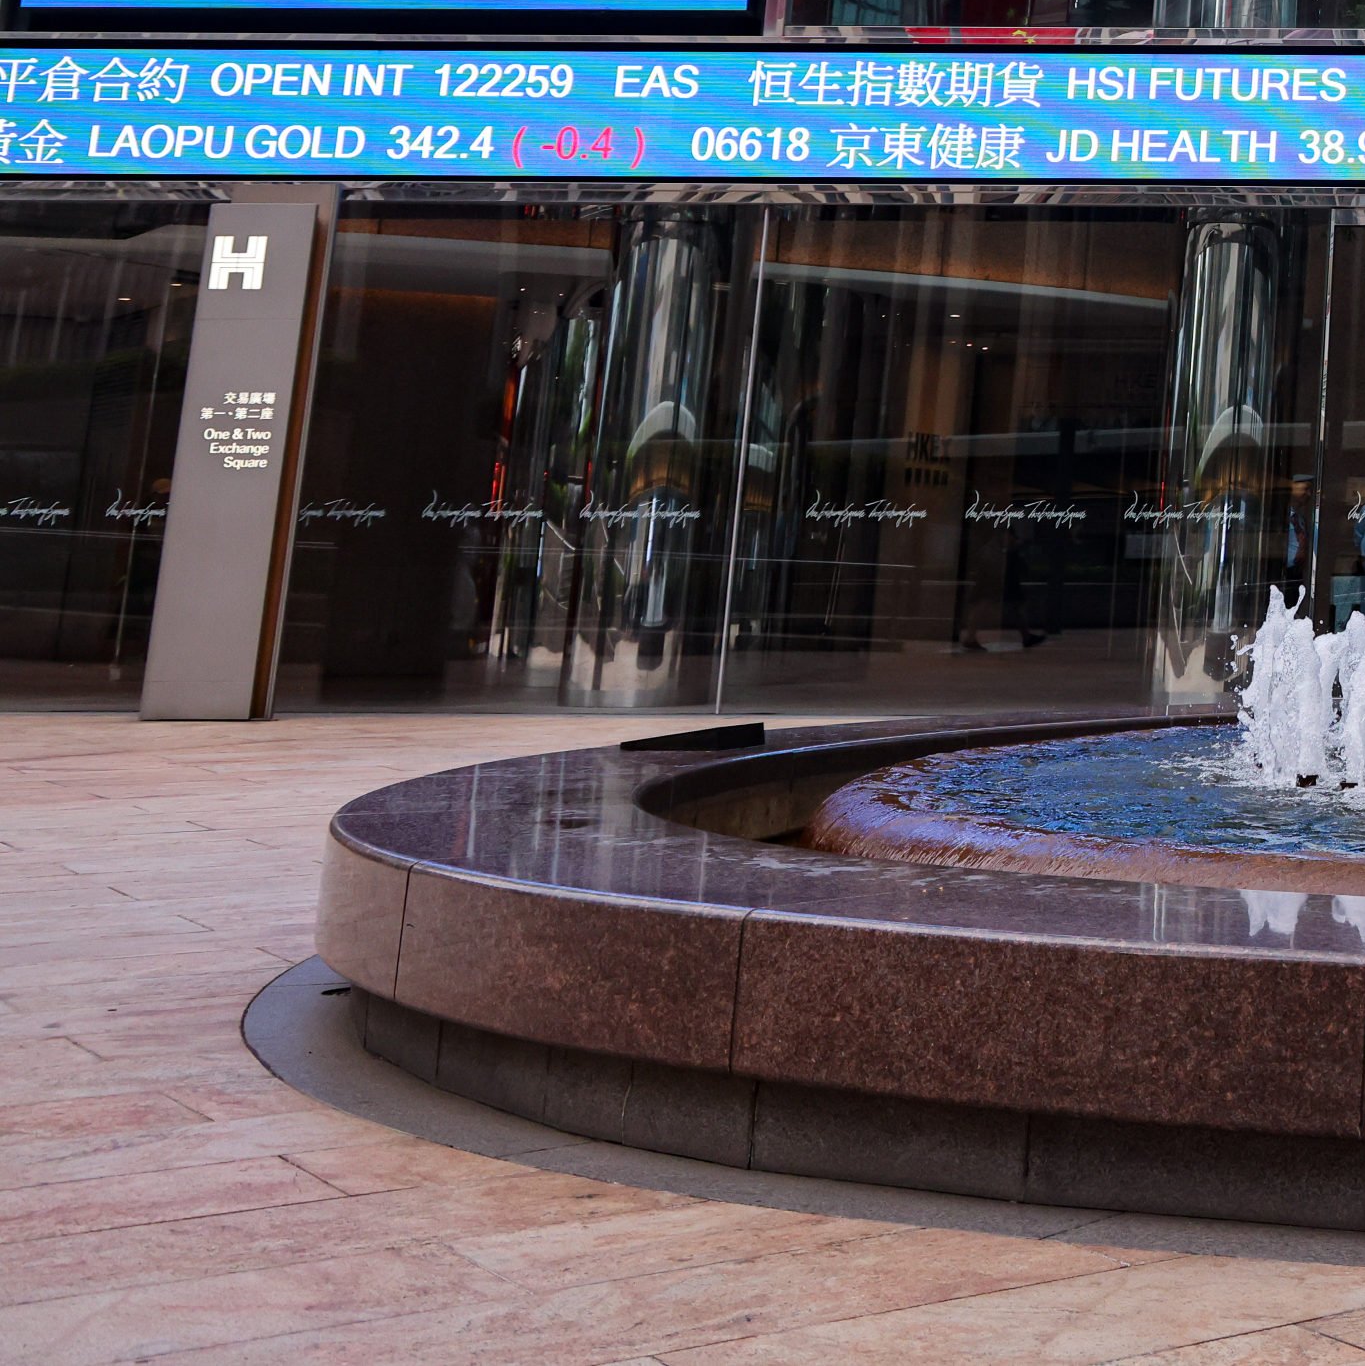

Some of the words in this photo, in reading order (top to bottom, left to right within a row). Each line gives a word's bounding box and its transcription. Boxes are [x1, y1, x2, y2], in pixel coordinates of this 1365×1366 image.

[211, 63, 331, 96] OPEN
[344, 65, 413, 95] INT
[436, 64, 573, 97] 122259
[615, 65, 698, 98] EAS
[749, 61, 1043, 107] 恒生指數期貨
[1068, 67, 1135, 100] HSI
[1150, 68, 1346, 101] FUTURES
[89, 125, 233, 158] LAOPU
[246, 125, 365, 158] GOLD
[387, 126, 493, 158] 342.4
[692, 127, 809, 161] 06618
[827, 124, 1025, 169] 京東健康
[1047, 130, 1098, 162] JD
[1111, 130, 1276, 162] HEALTH
[204, 428, 230, 439] One
[232, 428, 243, 439] &
[246, 429, 271, 439] Two
[210, 443, 269, 456] Exchange
[224, 457, 267, 470] Square
